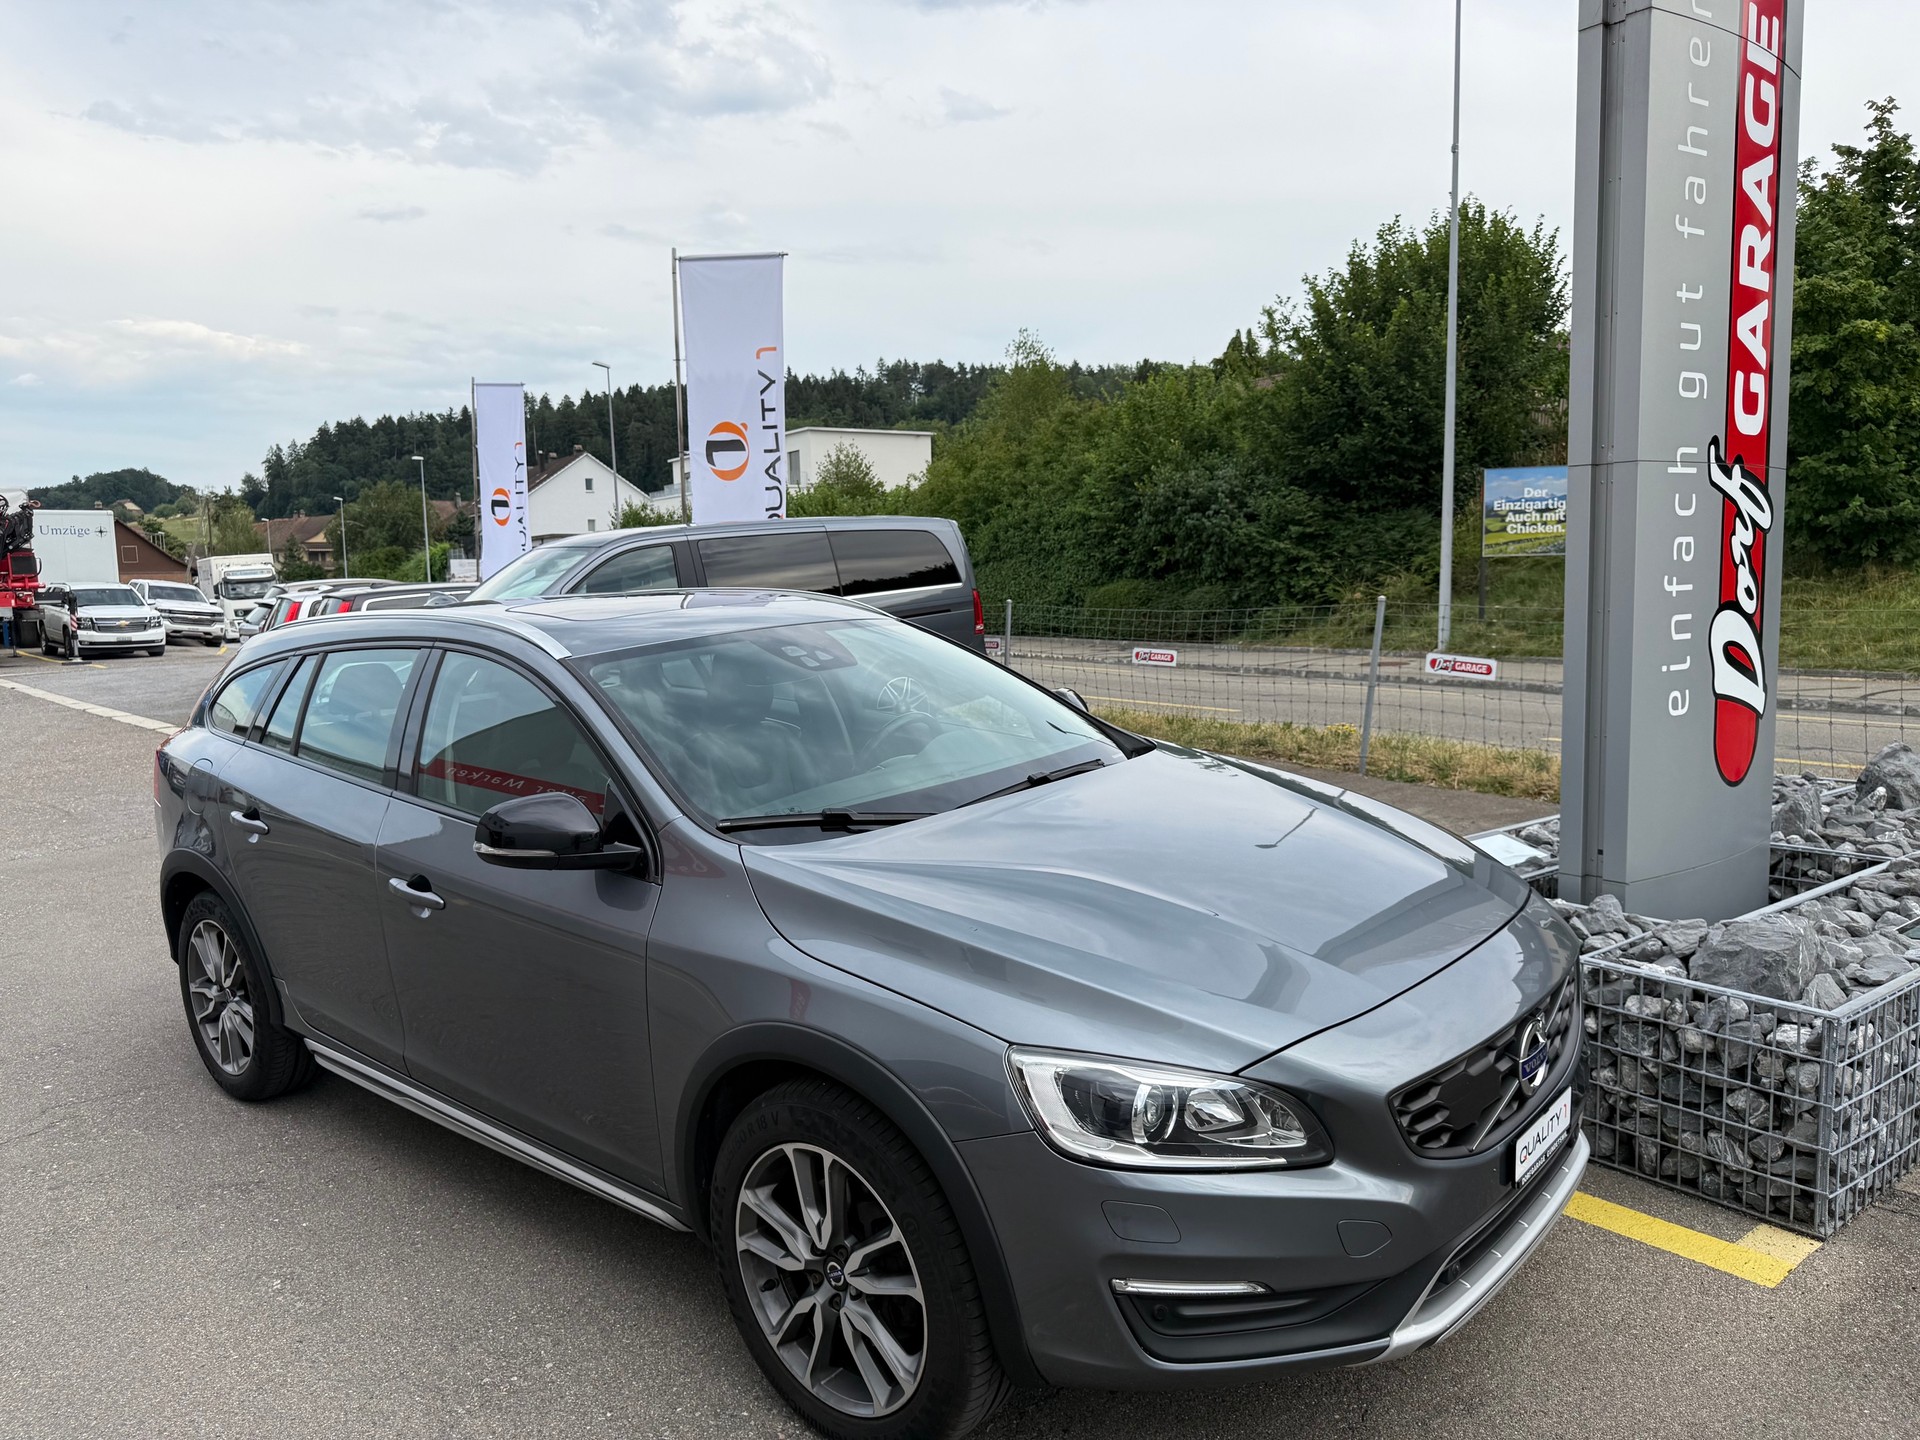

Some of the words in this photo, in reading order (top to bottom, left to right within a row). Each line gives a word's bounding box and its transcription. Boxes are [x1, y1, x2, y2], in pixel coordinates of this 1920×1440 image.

[1733, 1, 1780, 436] GARAGE
[1676, 282, 1708, 399] gut
[755, 346, 777, 360] 1
[757, 369, 784, 519] UALITY
[1523, 487, 1548, 498] Der
[514, 456, 527, 551] UALITY
[1493, 497, 1567, 512] Einzigartig
[1505, 511, 1540, 523] Auch
[1542, 509, 1566, 521] mit
[39, 525, 91, 538] Umzüge
[1506, 522, 1566, 534] Chicken.
[1661, 446, 1698, 717] einfach
[1708, 438, 1772, 718] Dorf
[1150, 653, 1172, 662] GARAGE
[1434, 657, 1457, 673] Dorf
[1454, 662, 1488, 674] GARAGE
[1519, 1107, 1563, 1165] QUALITY
